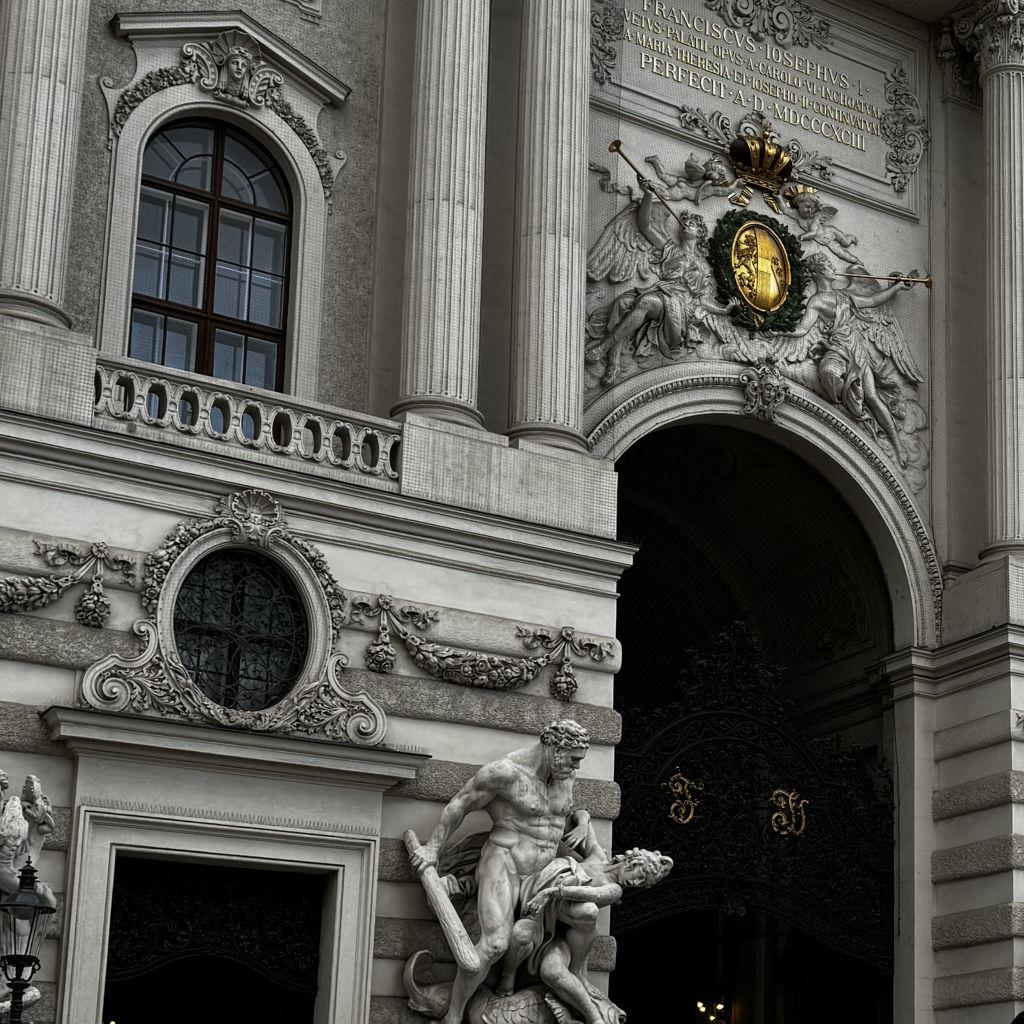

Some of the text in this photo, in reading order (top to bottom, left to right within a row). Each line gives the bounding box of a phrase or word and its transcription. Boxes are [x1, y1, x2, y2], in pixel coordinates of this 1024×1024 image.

[635, 31, 672, 57] MARIA
[675, 46, 730, 79] THERESIA
[734, 70, 747, 86] ET
[751, 75, 798, 105] IOSEPHO
[813, 101, 881, 136] CONTINVATVM
[642, 0, 756, 53] FRANCISCVS
[765, 43, 850, 89] IOSEPHVS
[713, 45, 743, 66] OPVS
[759, 62, 801, 89] CAROLO
[805, 80, 817, 96] VI
[820, 84, 881, 119] INCHOATVM
[640, 51, 727, 99] PERFECIT
[773, 102, 866, 152] MDCCCXCIII
